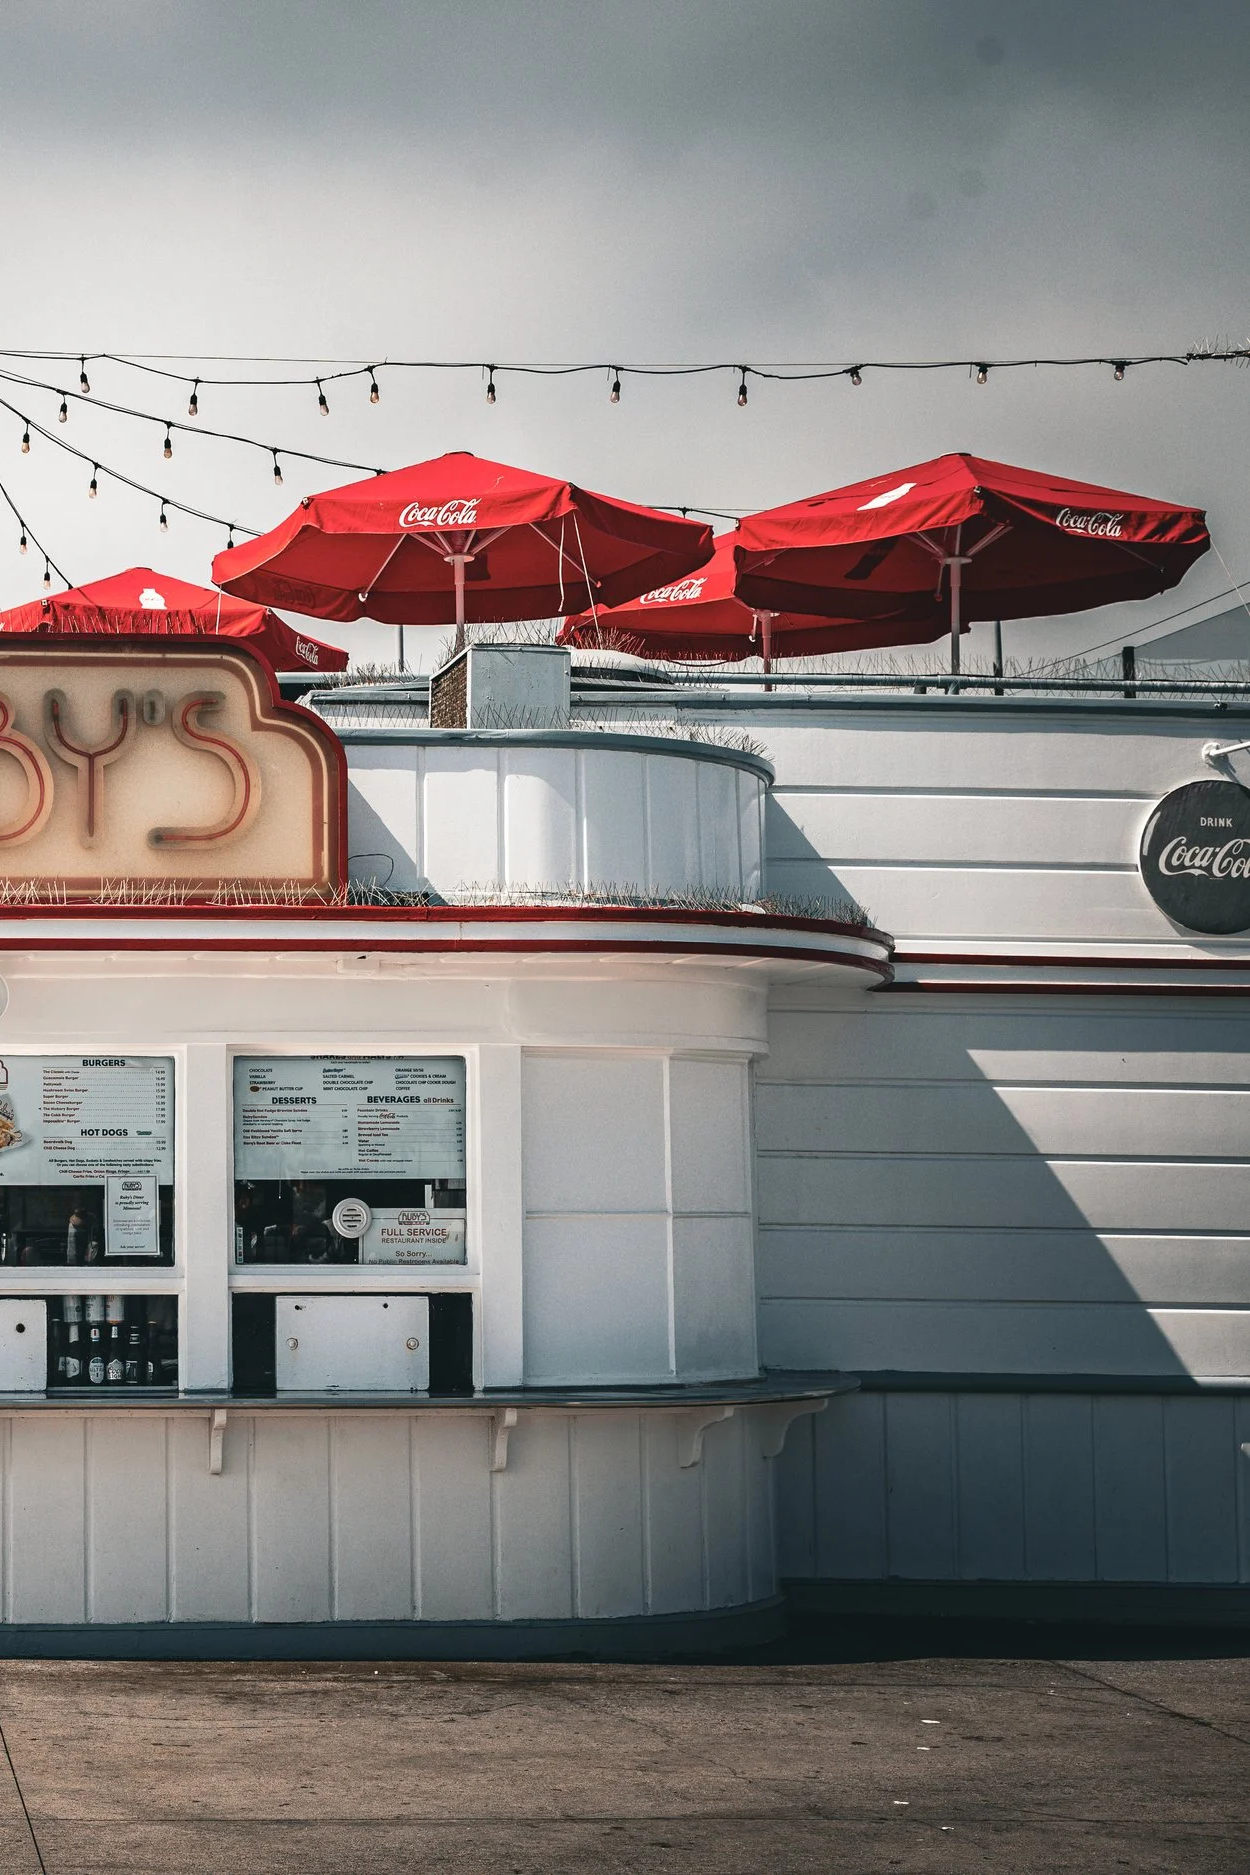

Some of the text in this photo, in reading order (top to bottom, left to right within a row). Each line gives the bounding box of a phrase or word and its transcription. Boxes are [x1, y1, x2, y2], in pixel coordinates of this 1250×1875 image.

[398, 498, 482, 528] Coca-Cola
[1056, 508, 1124, 536] Coca-Cola
[1200, 816, 1233, 828] DRINK
